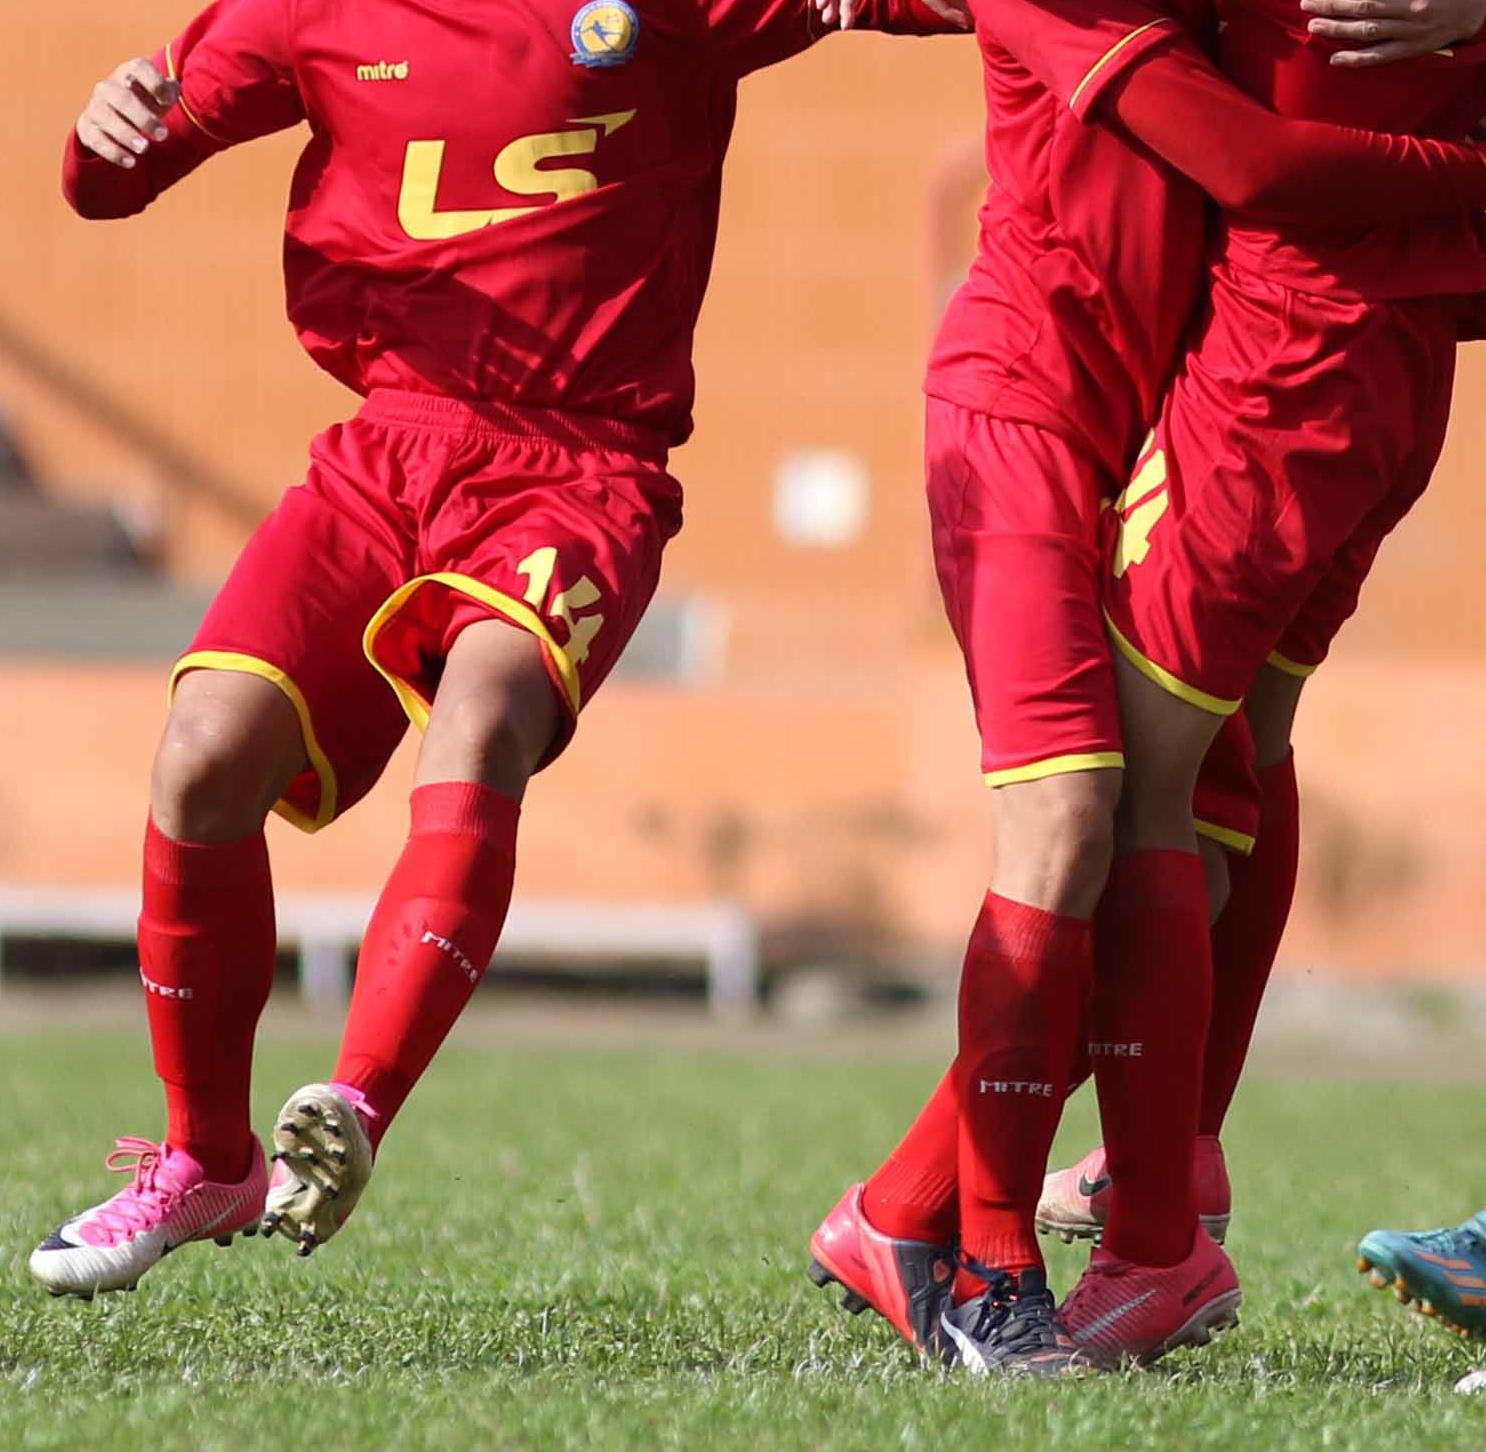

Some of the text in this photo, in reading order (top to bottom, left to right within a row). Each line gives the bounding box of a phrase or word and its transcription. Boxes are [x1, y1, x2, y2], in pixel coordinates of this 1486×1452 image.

[398, 123, 613, 241] LS
[517, 546, 604, 664] 14
[980, 1079, 1054, 1097] MITRE
